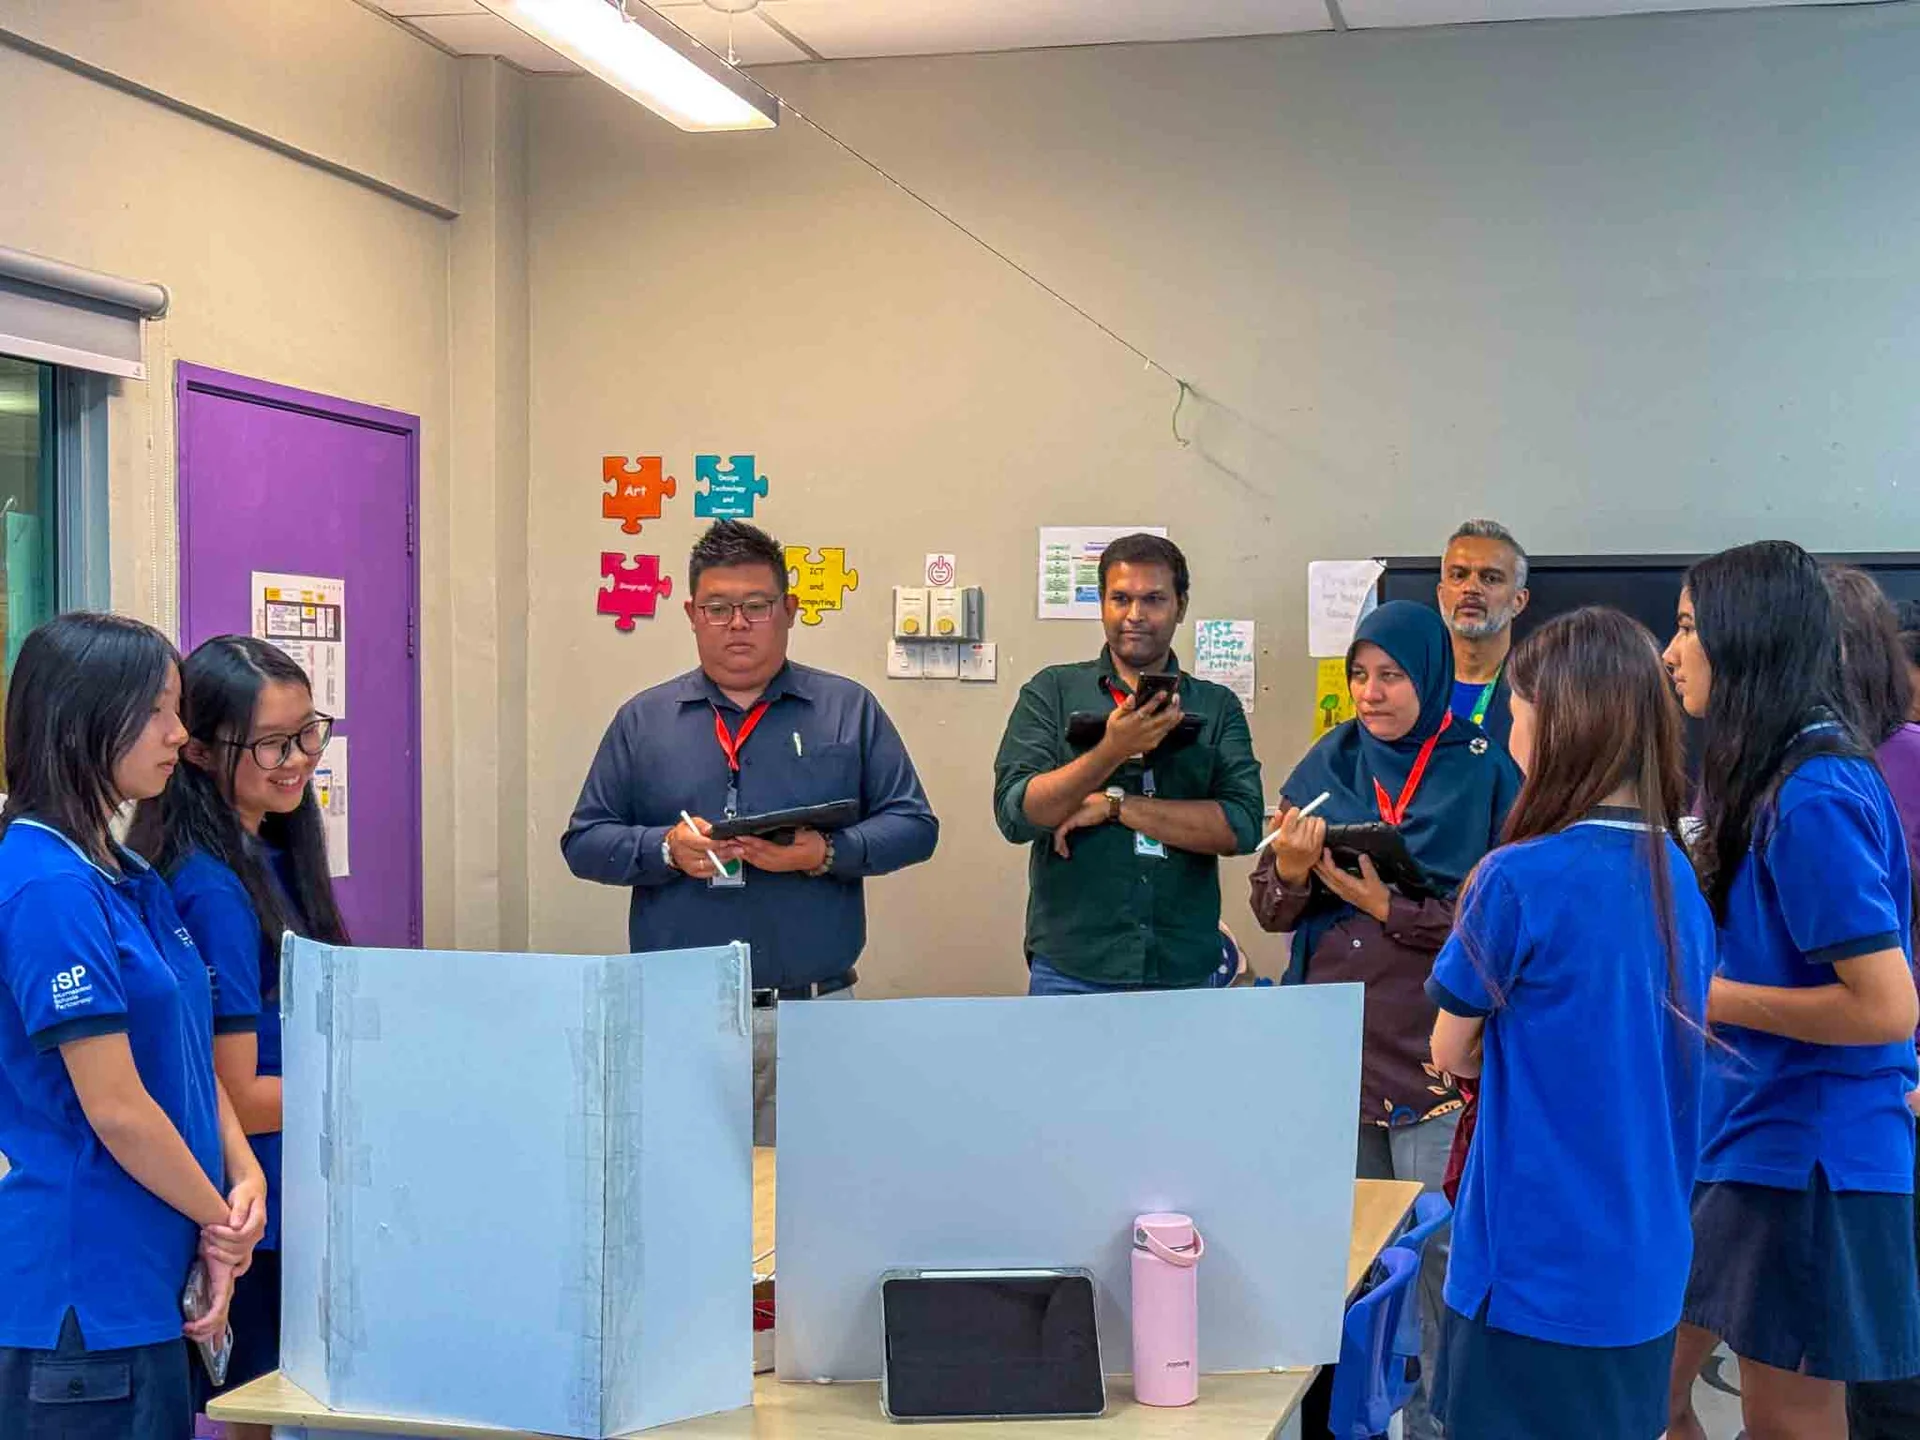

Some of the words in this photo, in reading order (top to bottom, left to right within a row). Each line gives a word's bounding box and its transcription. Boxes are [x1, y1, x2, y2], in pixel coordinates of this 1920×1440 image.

[624, 485, 647, 497] Art
[809, 567, 826, 576] ICT
[809, 581, 825, 591] and
[800, 599, 836, 608] omputing
